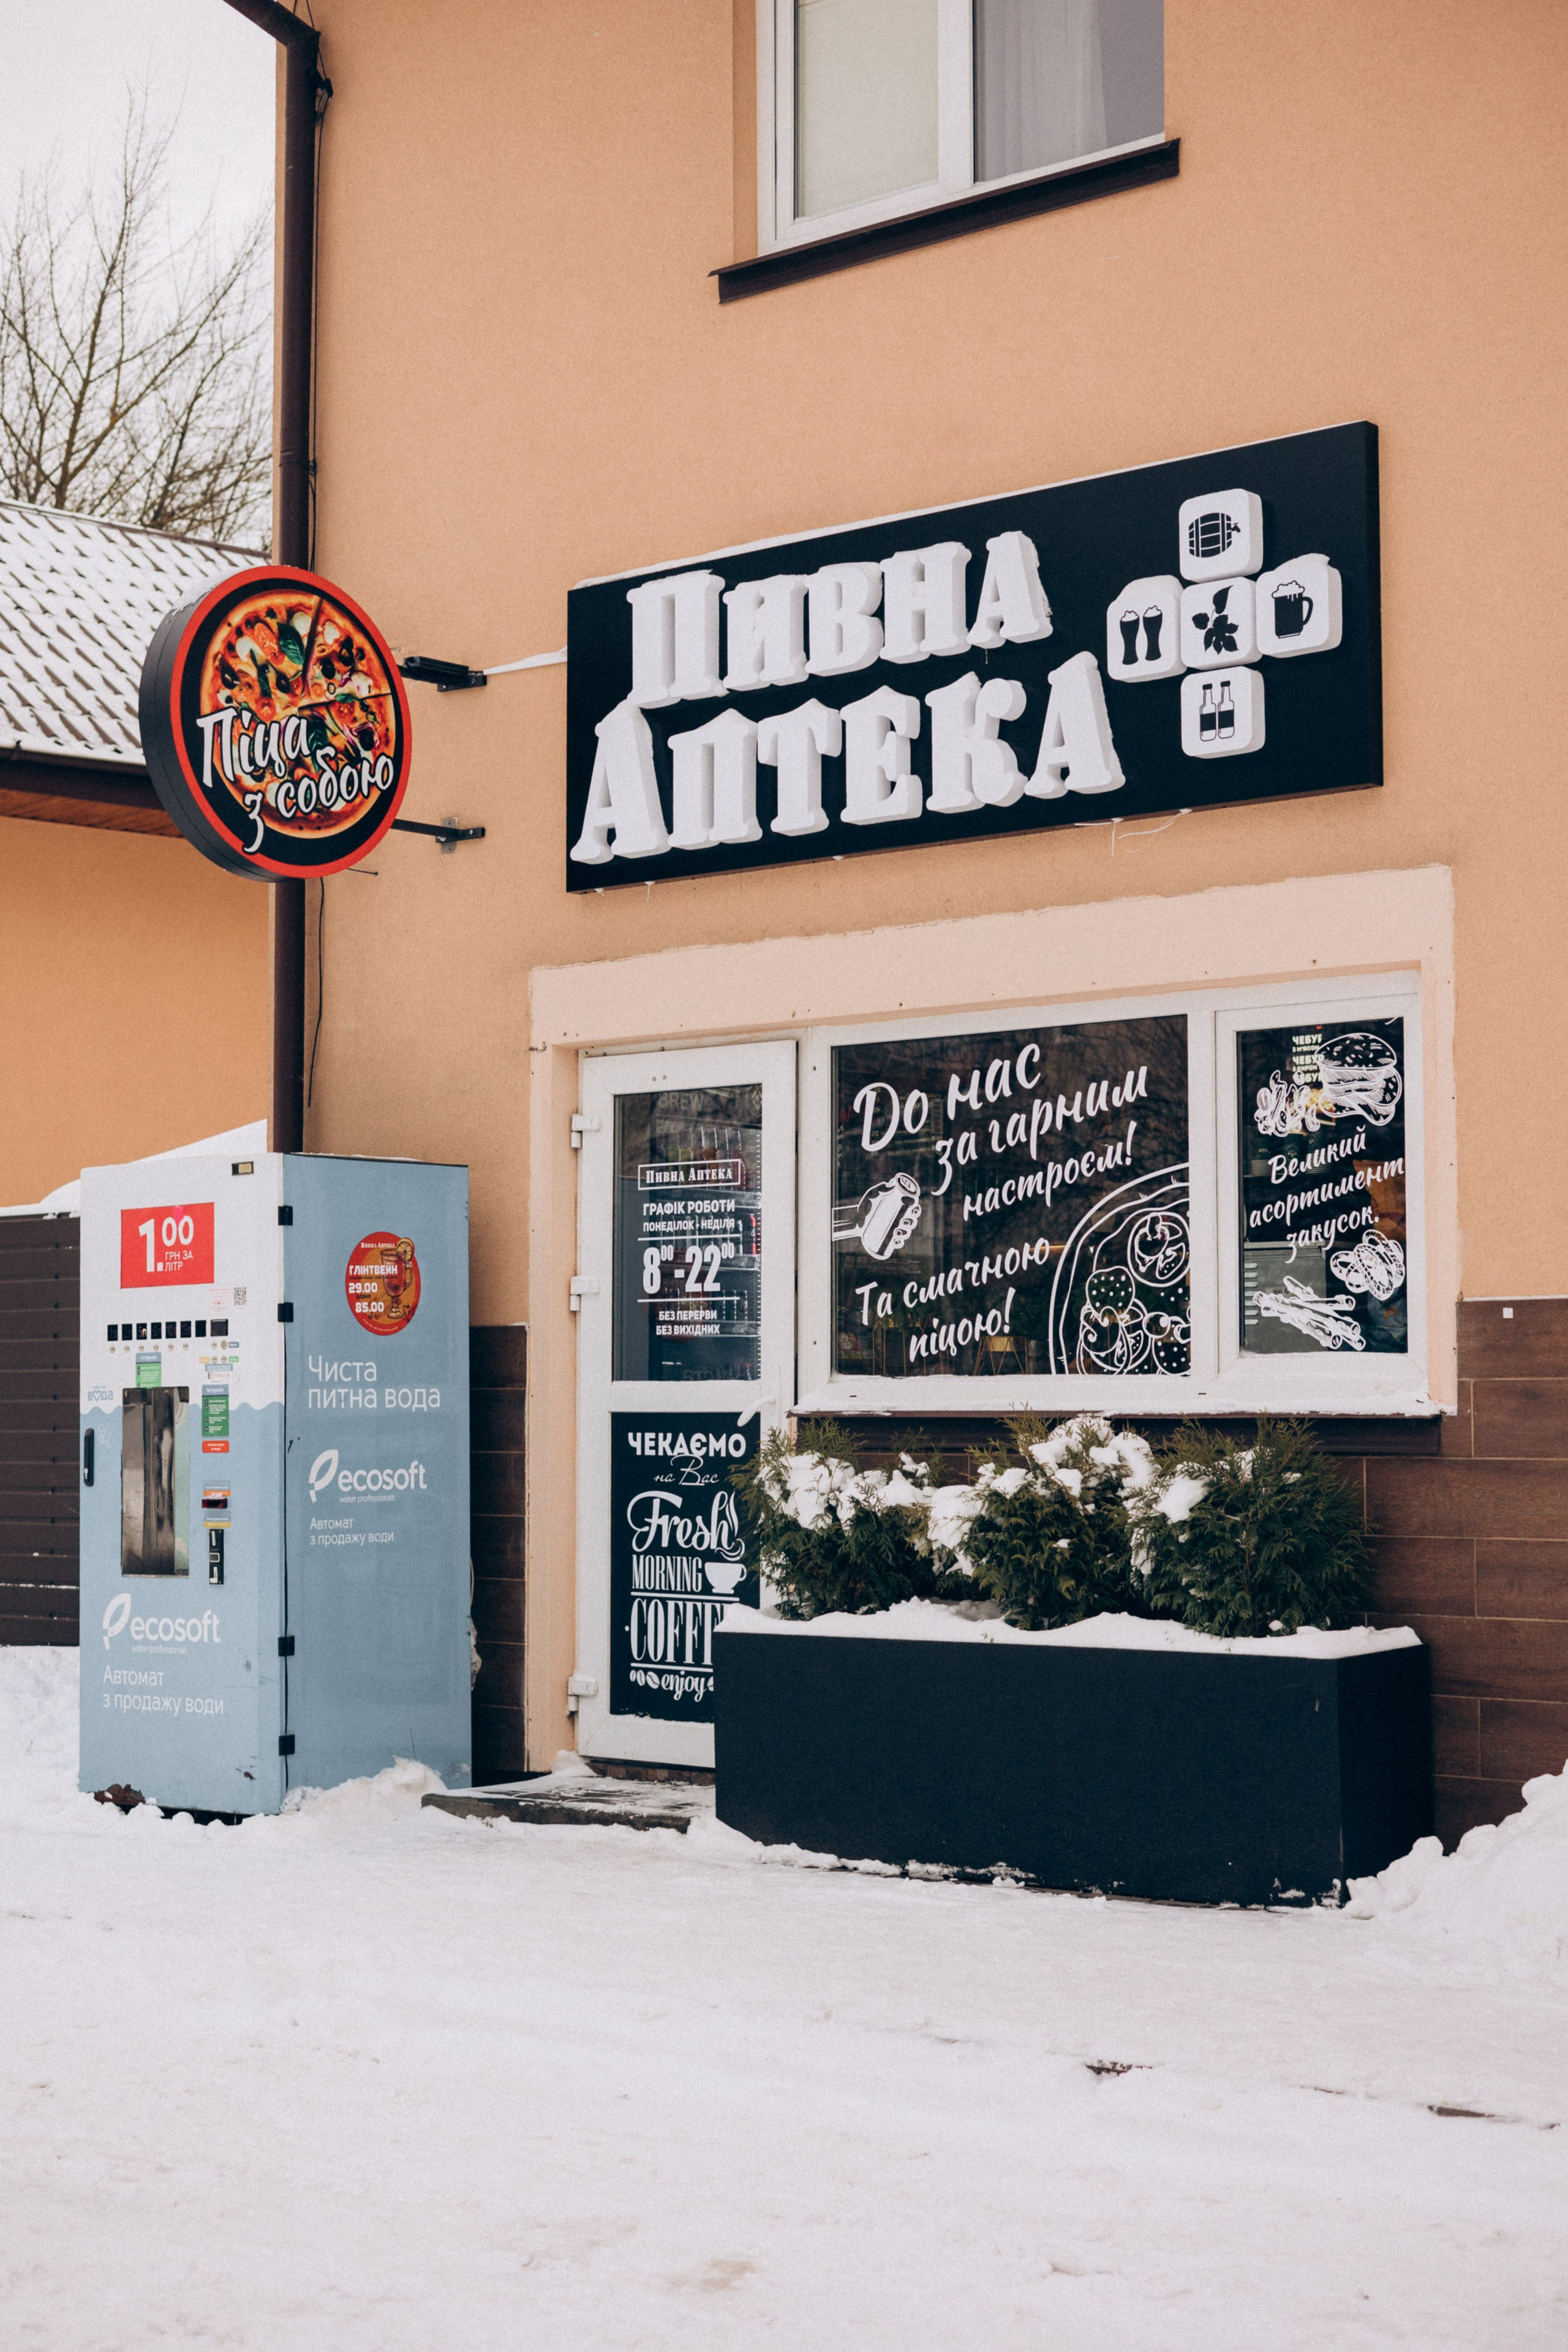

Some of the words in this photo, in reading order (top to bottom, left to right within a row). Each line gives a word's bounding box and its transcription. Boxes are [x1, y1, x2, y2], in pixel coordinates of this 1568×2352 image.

[197, 708, 311, 787] Піца
[244, 790, 264, 853] з
[277, 747, 394, 818] собою
[853, 1082, 929, 1152] До
[948, 1043, 1041, 1120] нас
[931, 1131, 977, 1195] за
[989, 1066, 1148, 1160] гарним
[1267, 1125, 1367, 1185] Великий
[963, 1121, 1137, 1221] настроєм!
[1250, 1157, 1405, 1228] асортимент
[643, 1201, 685, 1216] ГРАФІК
[687, 1199, 735, 1213] РОБОТИ
[643, 1219, 695, 1232] ПОНЕДІЛОК
[701, 1218, 735, 1231] НЕДІЛЯ
[1284, 1205, 1380, 1264] закусок.
[164, 1261, 183, 1272] ЛІТР
[165, 1251, 181, 1261] ГРН
[182, 1250, 194, 1260] ЗА
[349, 1262, 398, 1276] ГЛІНТВЕЙН
[349, 1283, 378, 1294] 29.00
[855, 1281, 892, 1326] Та
[903, 1237, 1050, 1308] смачною
[355, 1302, 385, 1313] 85.00
[658, 1311, 675, 1321] БЕЗ
[677, 1310, 717, 1320] ПЕРЕРВИ
[656, 1325, 673, 1335] БЕЗ
[674, 1324, 720, 1336] ВИХІДНИХ
[910, 1287, 1016, 1362] піцою!
[308, 1355, 377, 1382] Чиста
[308, 1388, 377, 1408] питна
[385, 1388, 440, 1411] вода
[628, 1432, 747, 1458] ЧЕКАЄМО
[337, 1460, 428, 1492] ecosoft
[654, 1473, 676, 1482] на
[670, 1453, 719, 1486] Вас
[310, 1517, 354, 1530] Автомат
[627, 1490, 735, 1553] Fresh
[318, 1534, 366, 1548] продажу
[369, 1532, 394, 1544] води
[631, 1554, 703, 1593] MORNING
[130, 1609, 221, 1643] ecosoft
[103, 1665, 164, 1686] Автомат
[661, 1670, 707, 1703] enjoy
[115, 1694, 181, 1716] продажу
[186, 1697, 224, 1716] води
